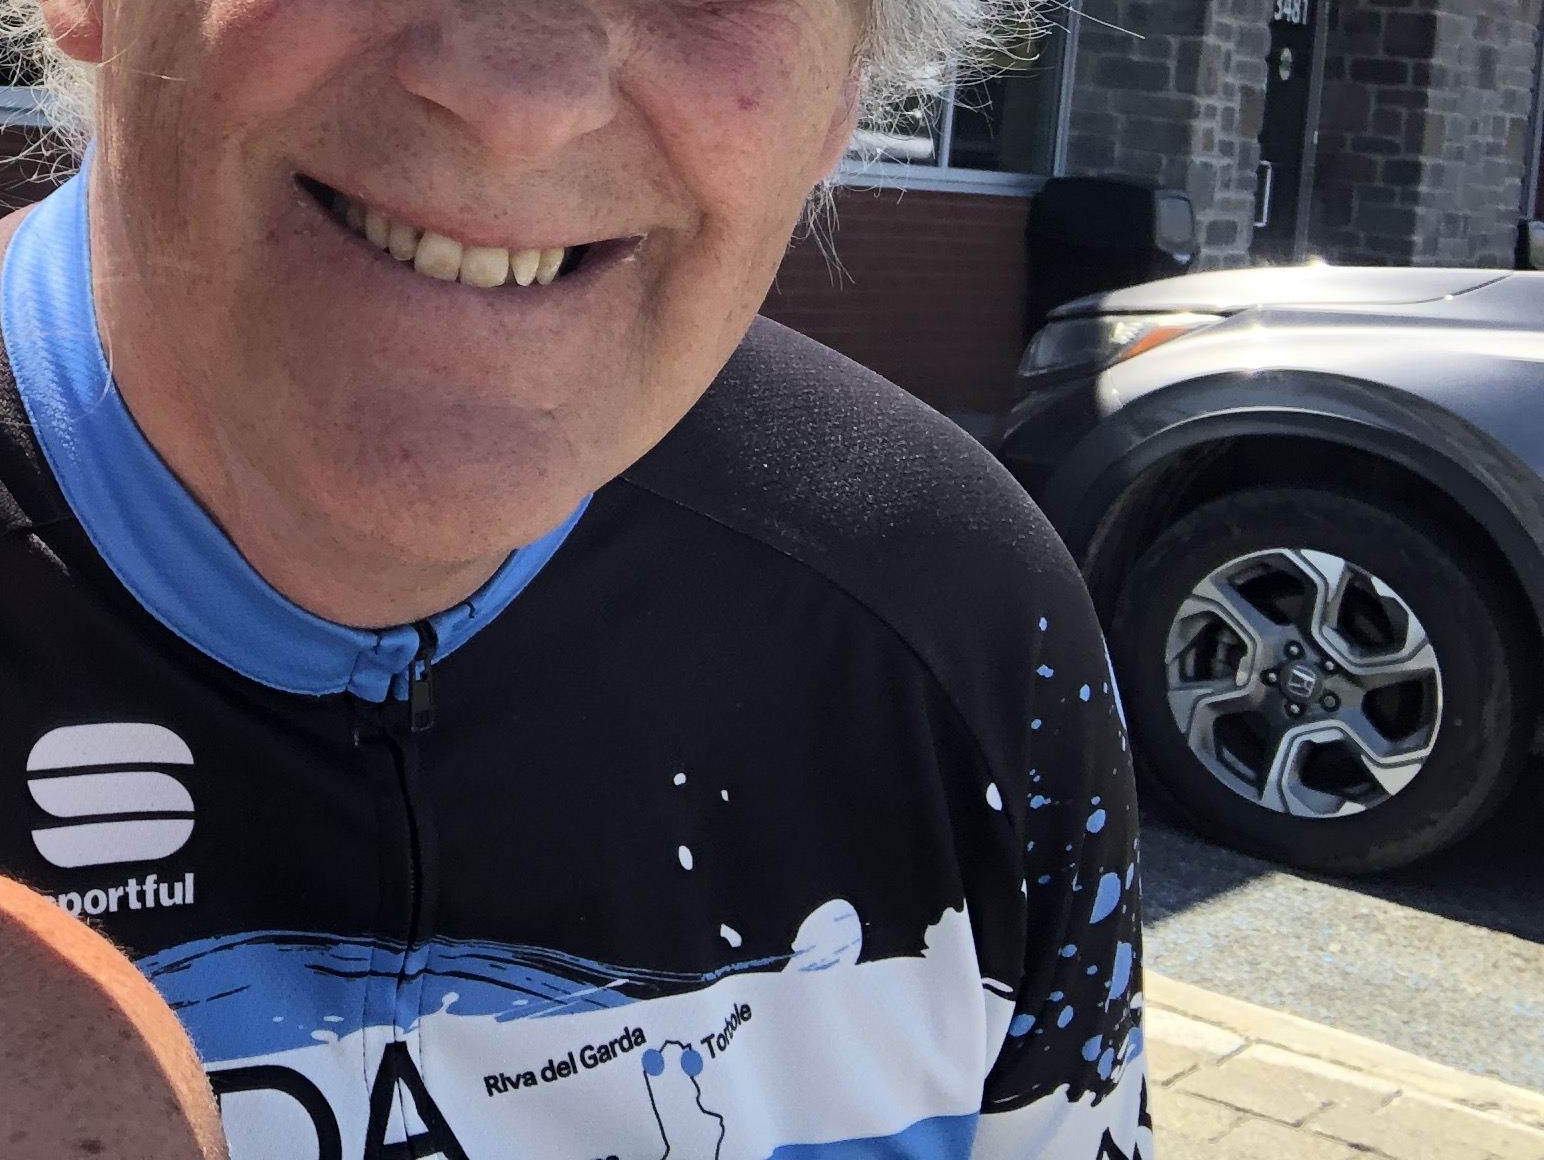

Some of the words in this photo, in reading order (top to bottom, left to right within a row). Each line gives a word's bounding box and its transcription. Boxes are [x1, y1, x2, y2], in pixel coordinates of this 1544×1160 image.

[484, 1070, 538, 1097] Riva
[540, 1051, 578, 1083] del
[579, 1026, 647, 1070] Garda
